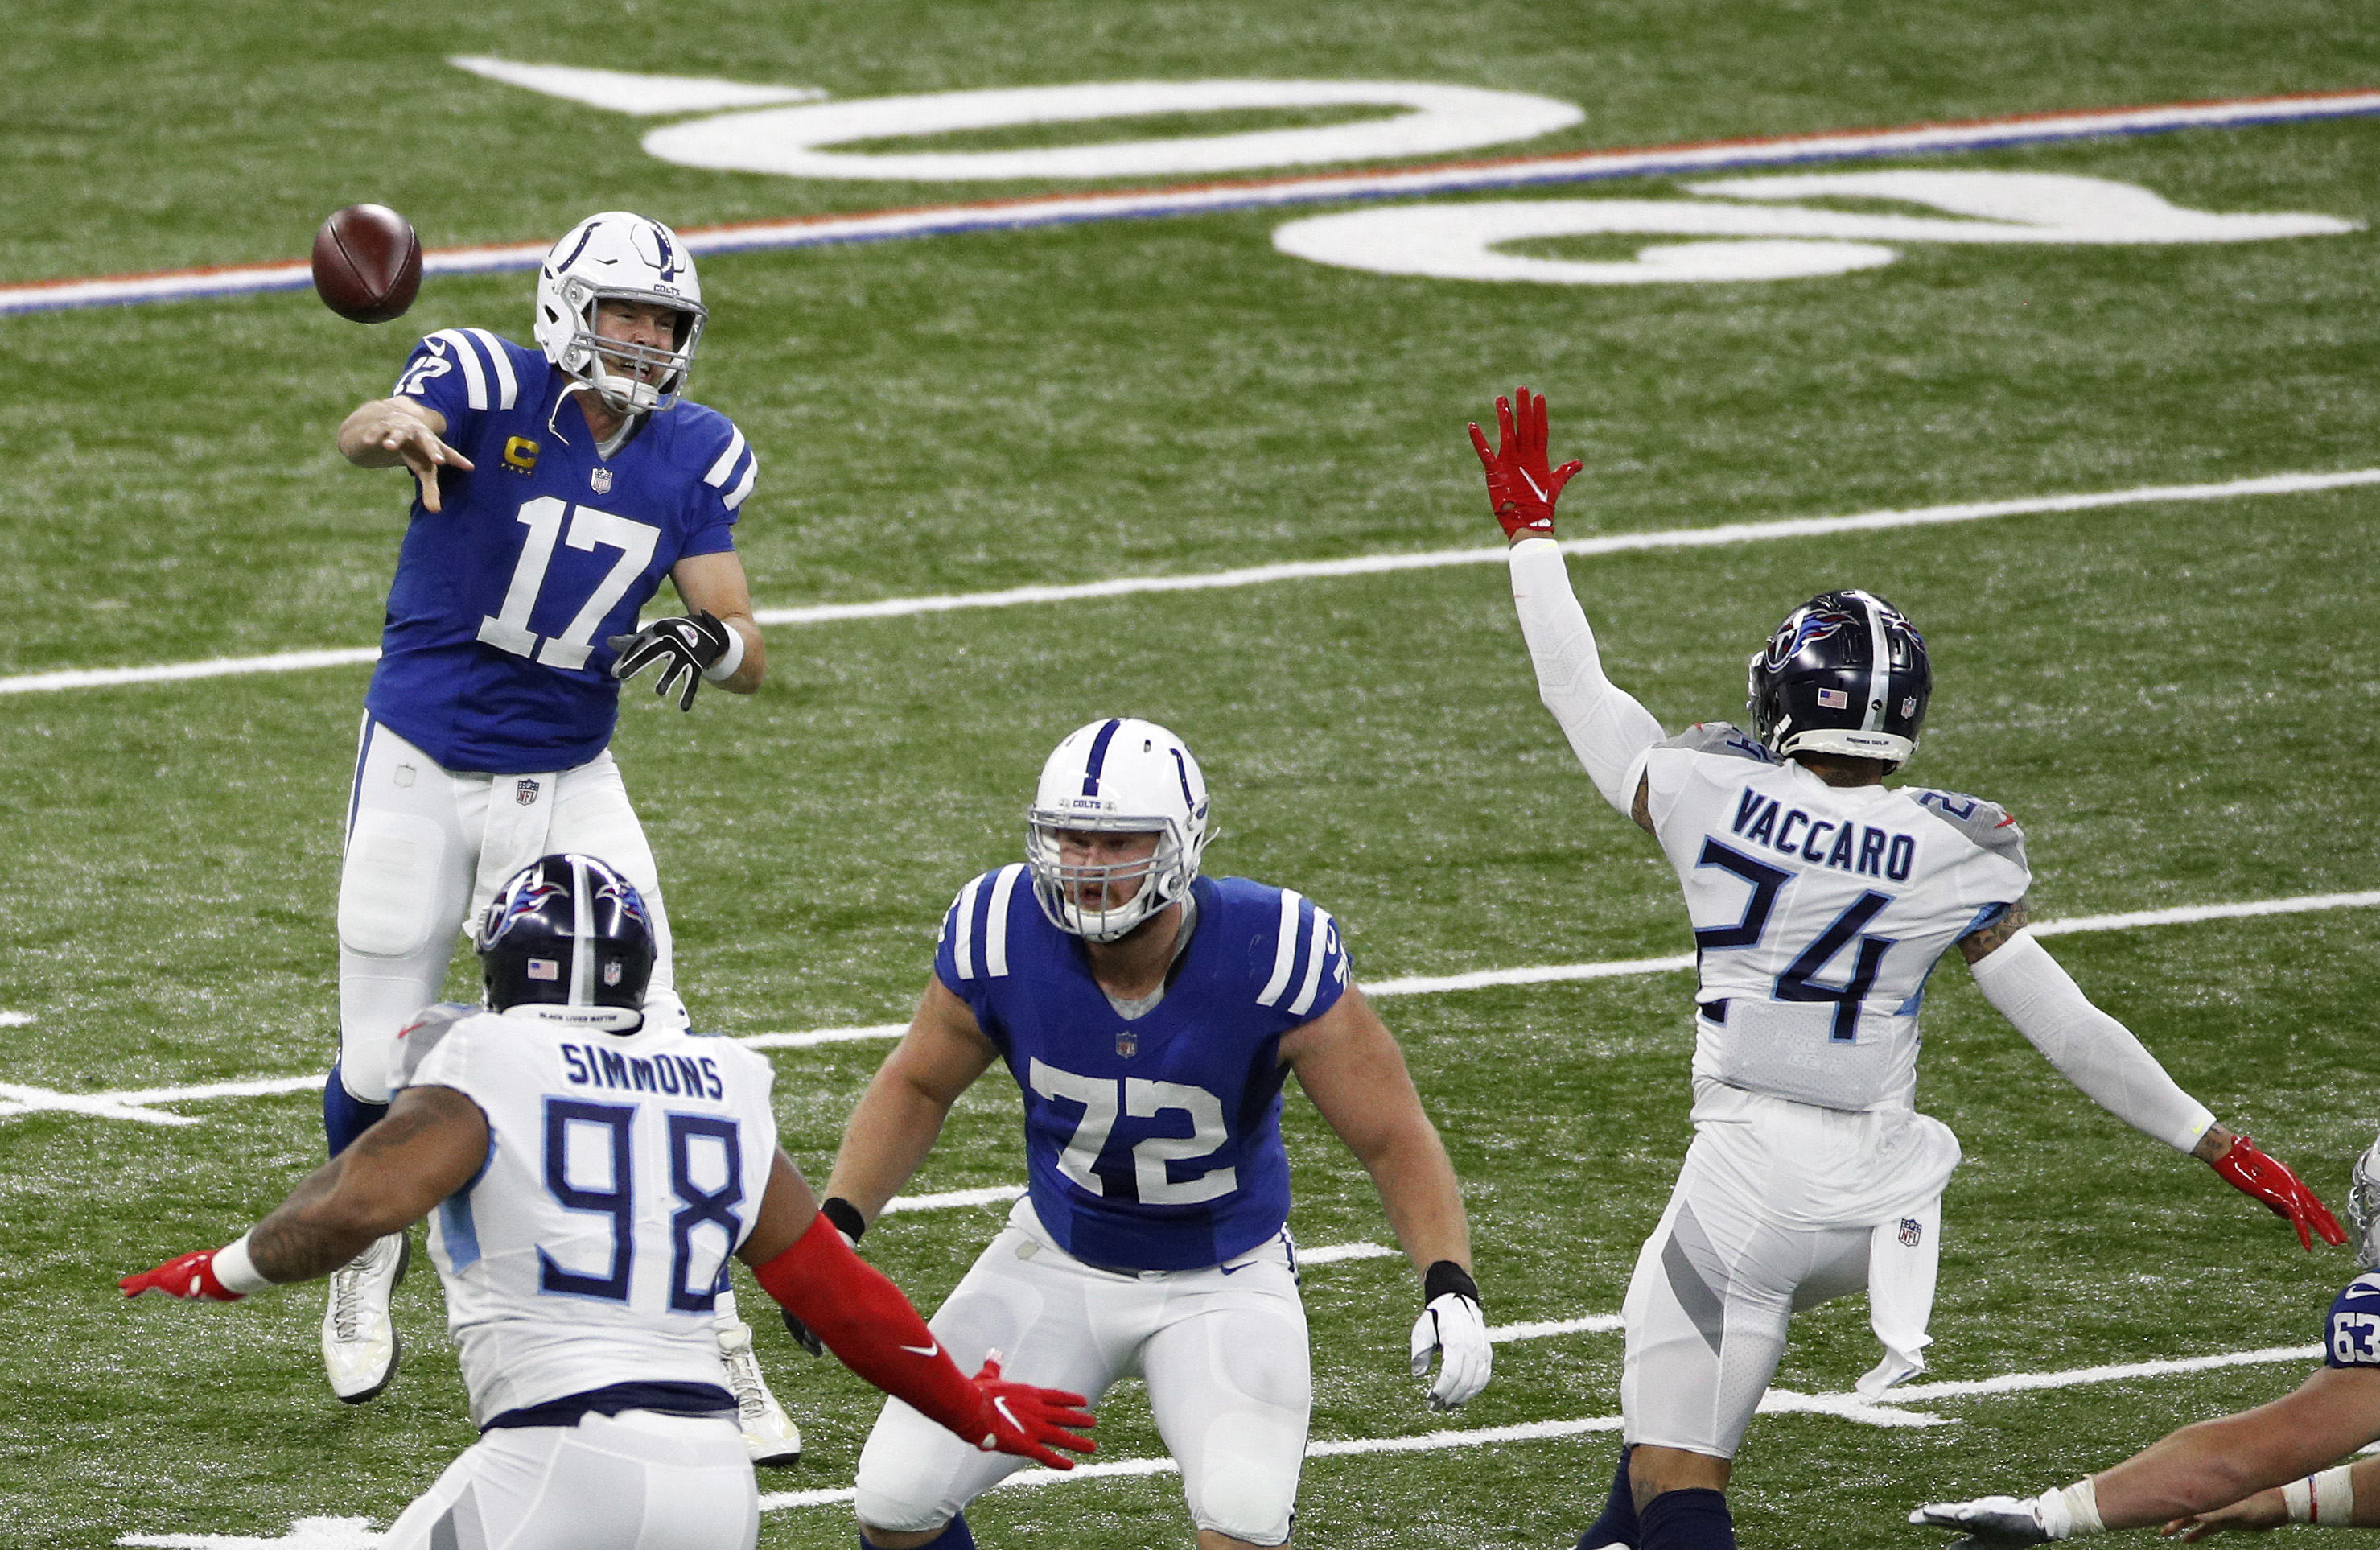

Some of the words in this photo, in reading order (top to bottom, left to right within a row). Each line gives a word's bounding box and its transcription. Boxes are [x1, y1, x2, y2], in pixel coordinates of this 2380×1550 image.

[653, 284, 681, 296] COLTS
[504, 435, 539, 468] C
[476, 495, 661, 670] 17
[1073, 800, 1101, 809] COLTS
[1731, 785, 1916, 882] VACCARO
[1694, 834, 1898, 1044] 24
[560, 1044, 723, 1101] SIMMONS
[1029, 1056, 1238, 1206] 72
[535, 1093, 747, 1317] 98
[2333, 1312, 2380, 1363] 63
